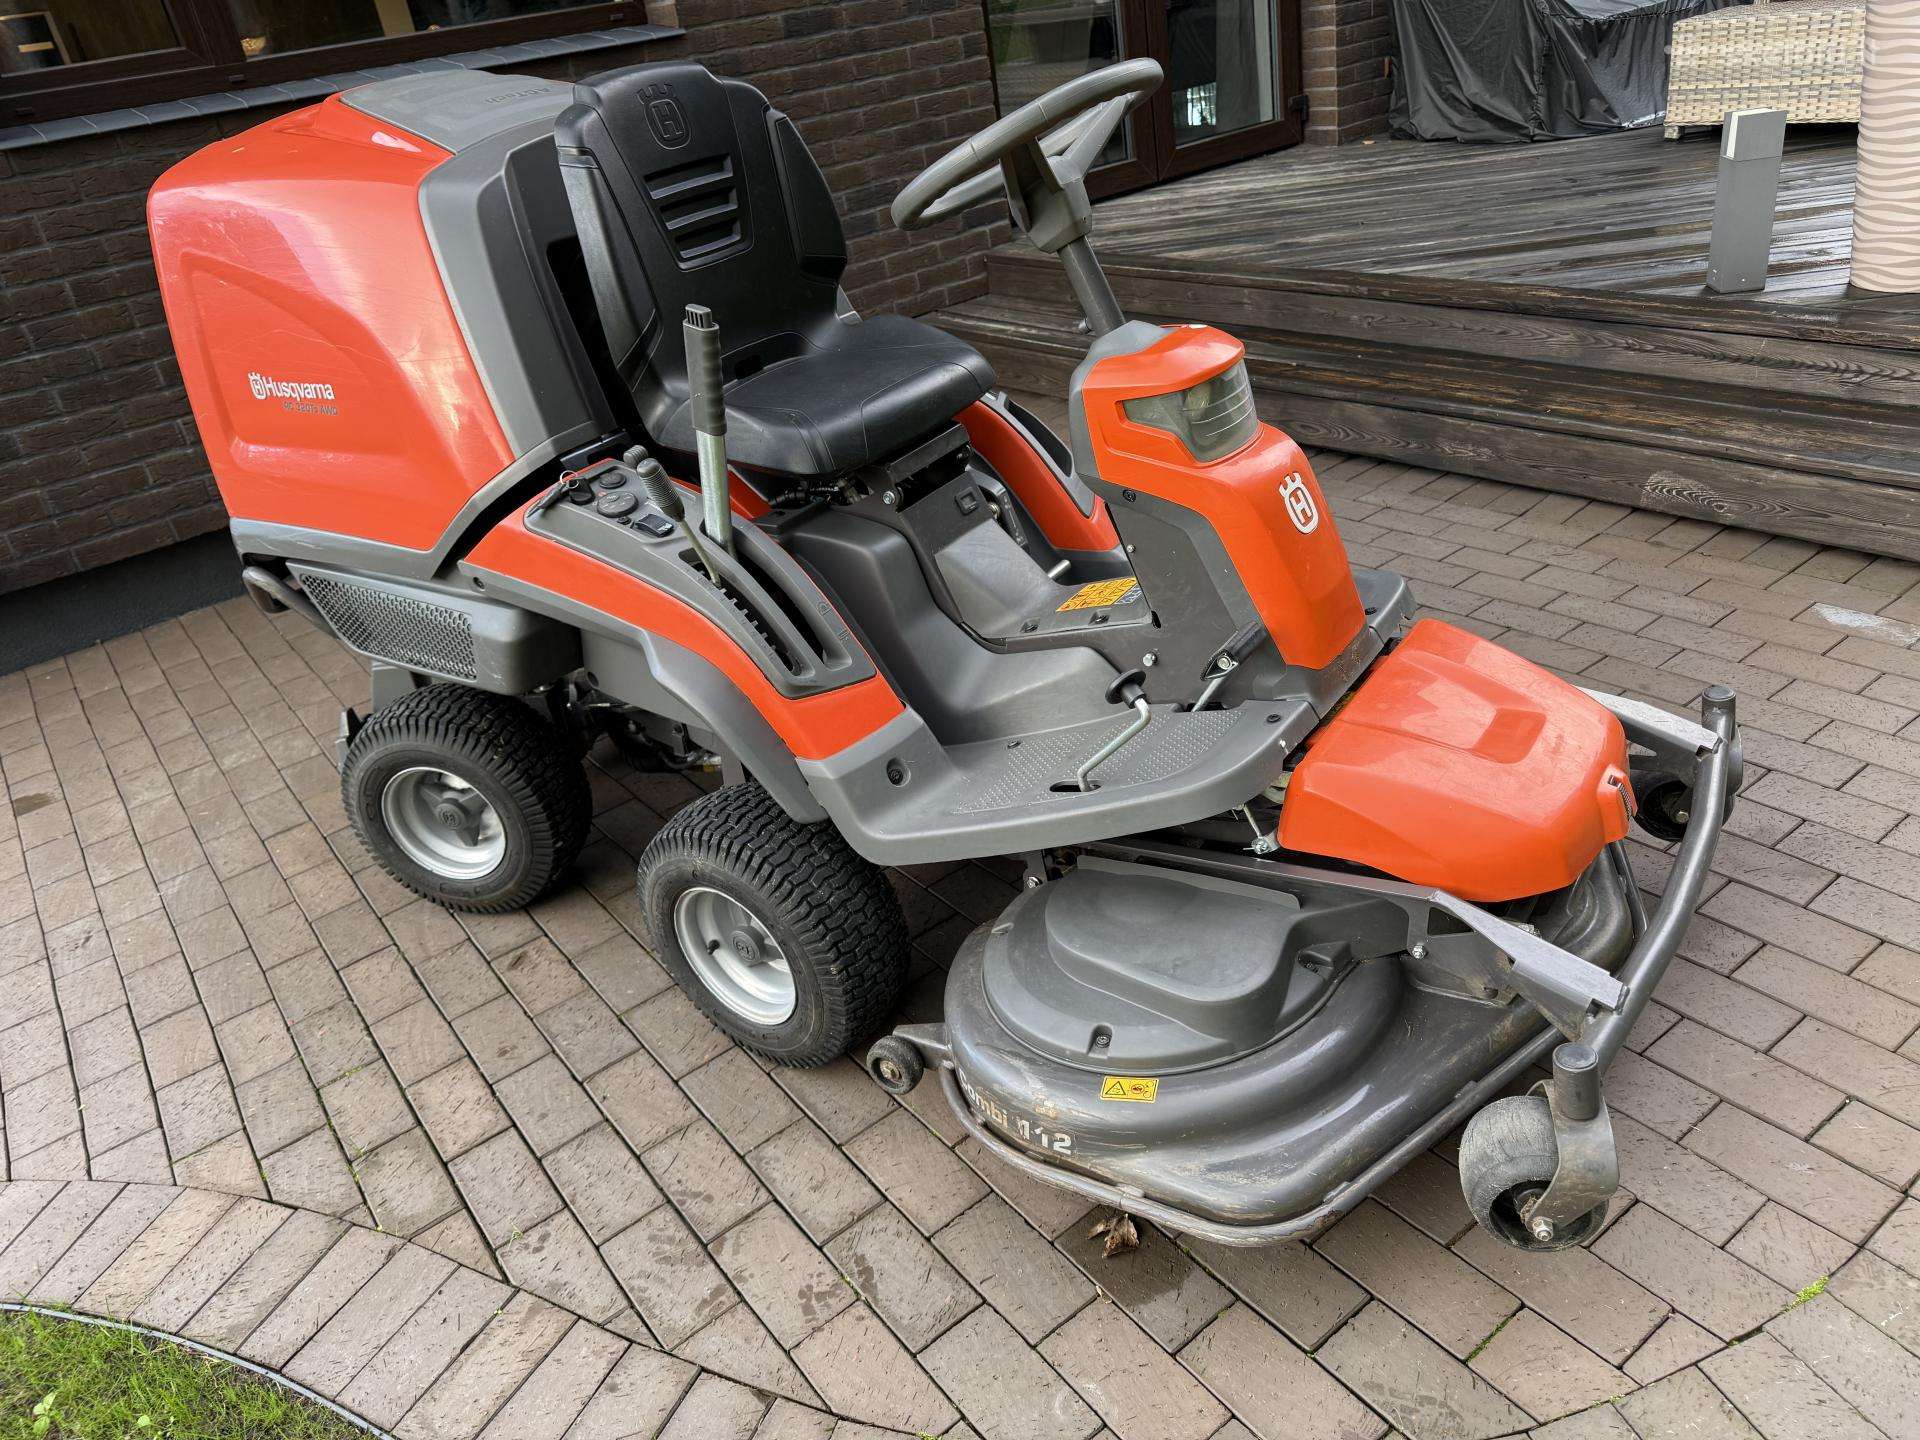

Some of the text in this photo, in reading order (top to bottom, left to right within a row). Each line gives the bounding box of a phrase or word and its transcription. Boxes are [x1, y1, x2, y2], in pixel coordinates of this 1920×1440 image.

[262, 376, 335, 402] Husqvarna
[958, 1067, 1072, 1155] Combi 112
